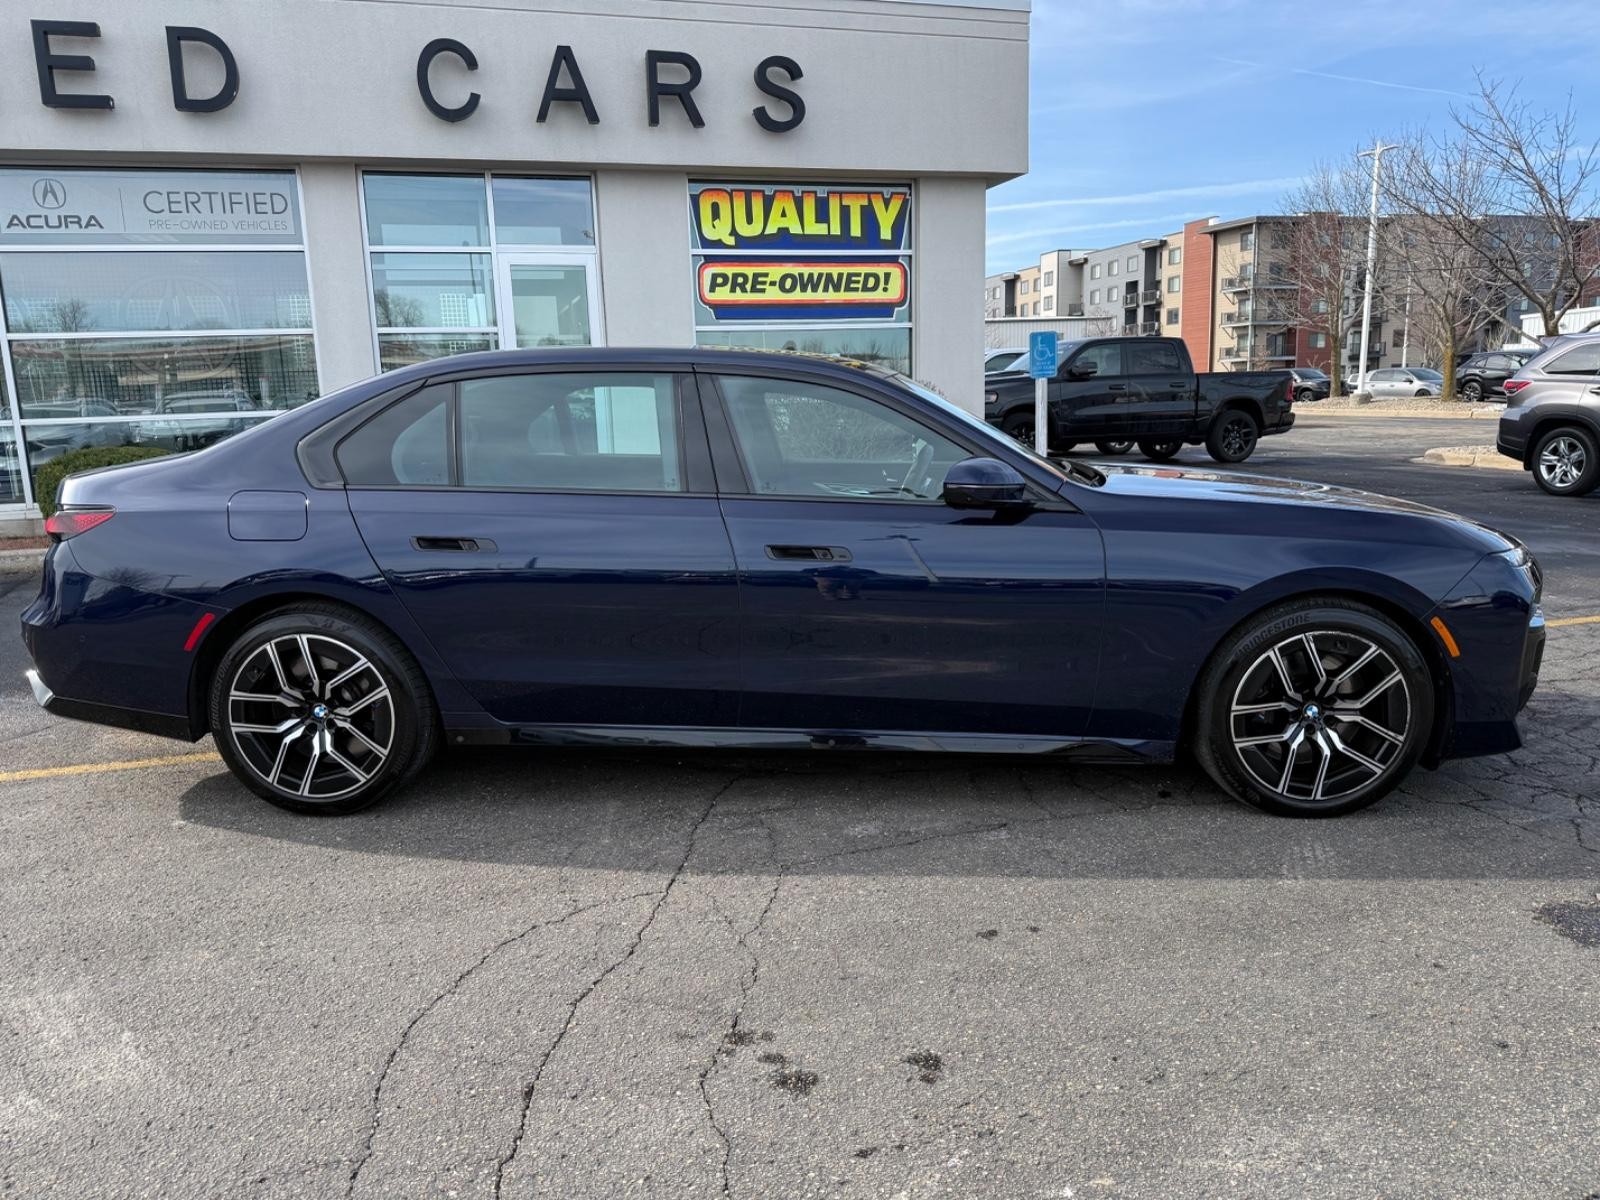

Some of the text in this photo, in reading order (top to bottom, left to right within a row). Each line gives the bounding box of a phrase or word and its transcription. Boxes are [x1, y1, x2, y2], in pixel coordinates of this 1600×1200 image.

[31, 19, 807, 133] ED CARS
[143, 189, 289, 216] CERTIFIED
[6, 214, 105, 230] ACURA
[148, 218, 288, 232] PRE-OWNED VEHICLES
[699, 188, 906, 247] QUALITY
[708, 271, 892, 295] PRE-OWNED!
